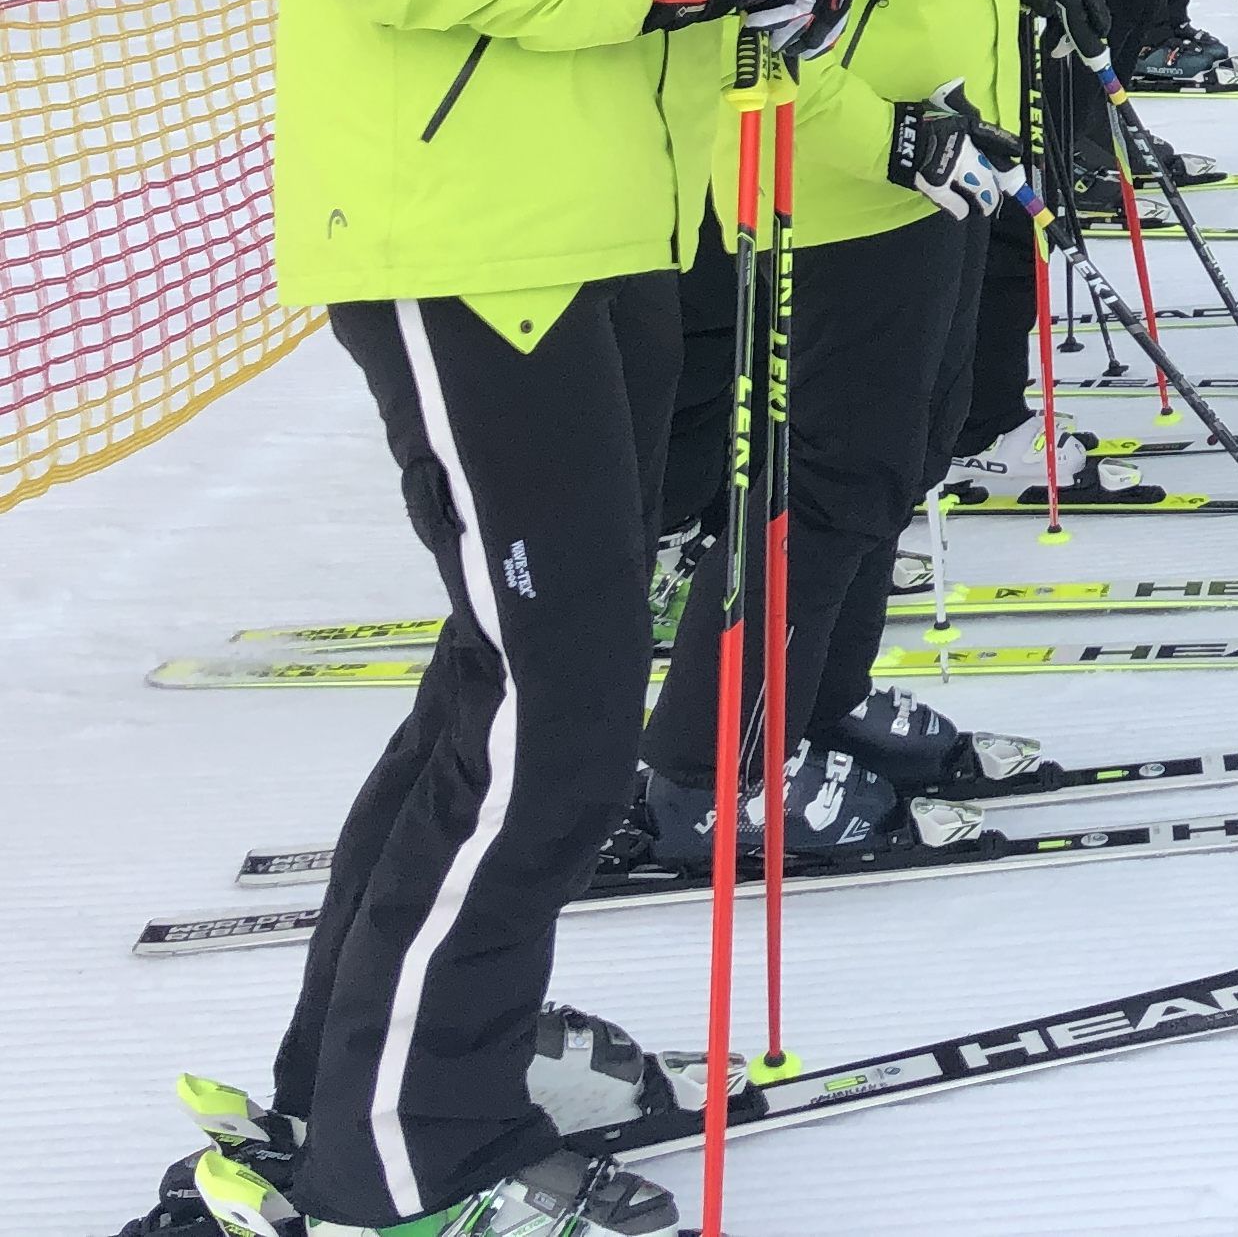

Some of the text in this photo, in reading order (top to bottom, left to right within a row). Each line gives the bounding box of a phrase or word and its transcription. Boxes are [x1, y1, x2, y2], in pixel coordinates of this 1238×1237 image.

[900, 114, 918, 168] LEKI
[1028, 88, 1045, 155] LEKI
[1063, 246, 1119, 306] LEKI
[767, 328, 788, 423] LEKI
[734, 374, 753, 490] LEKI
